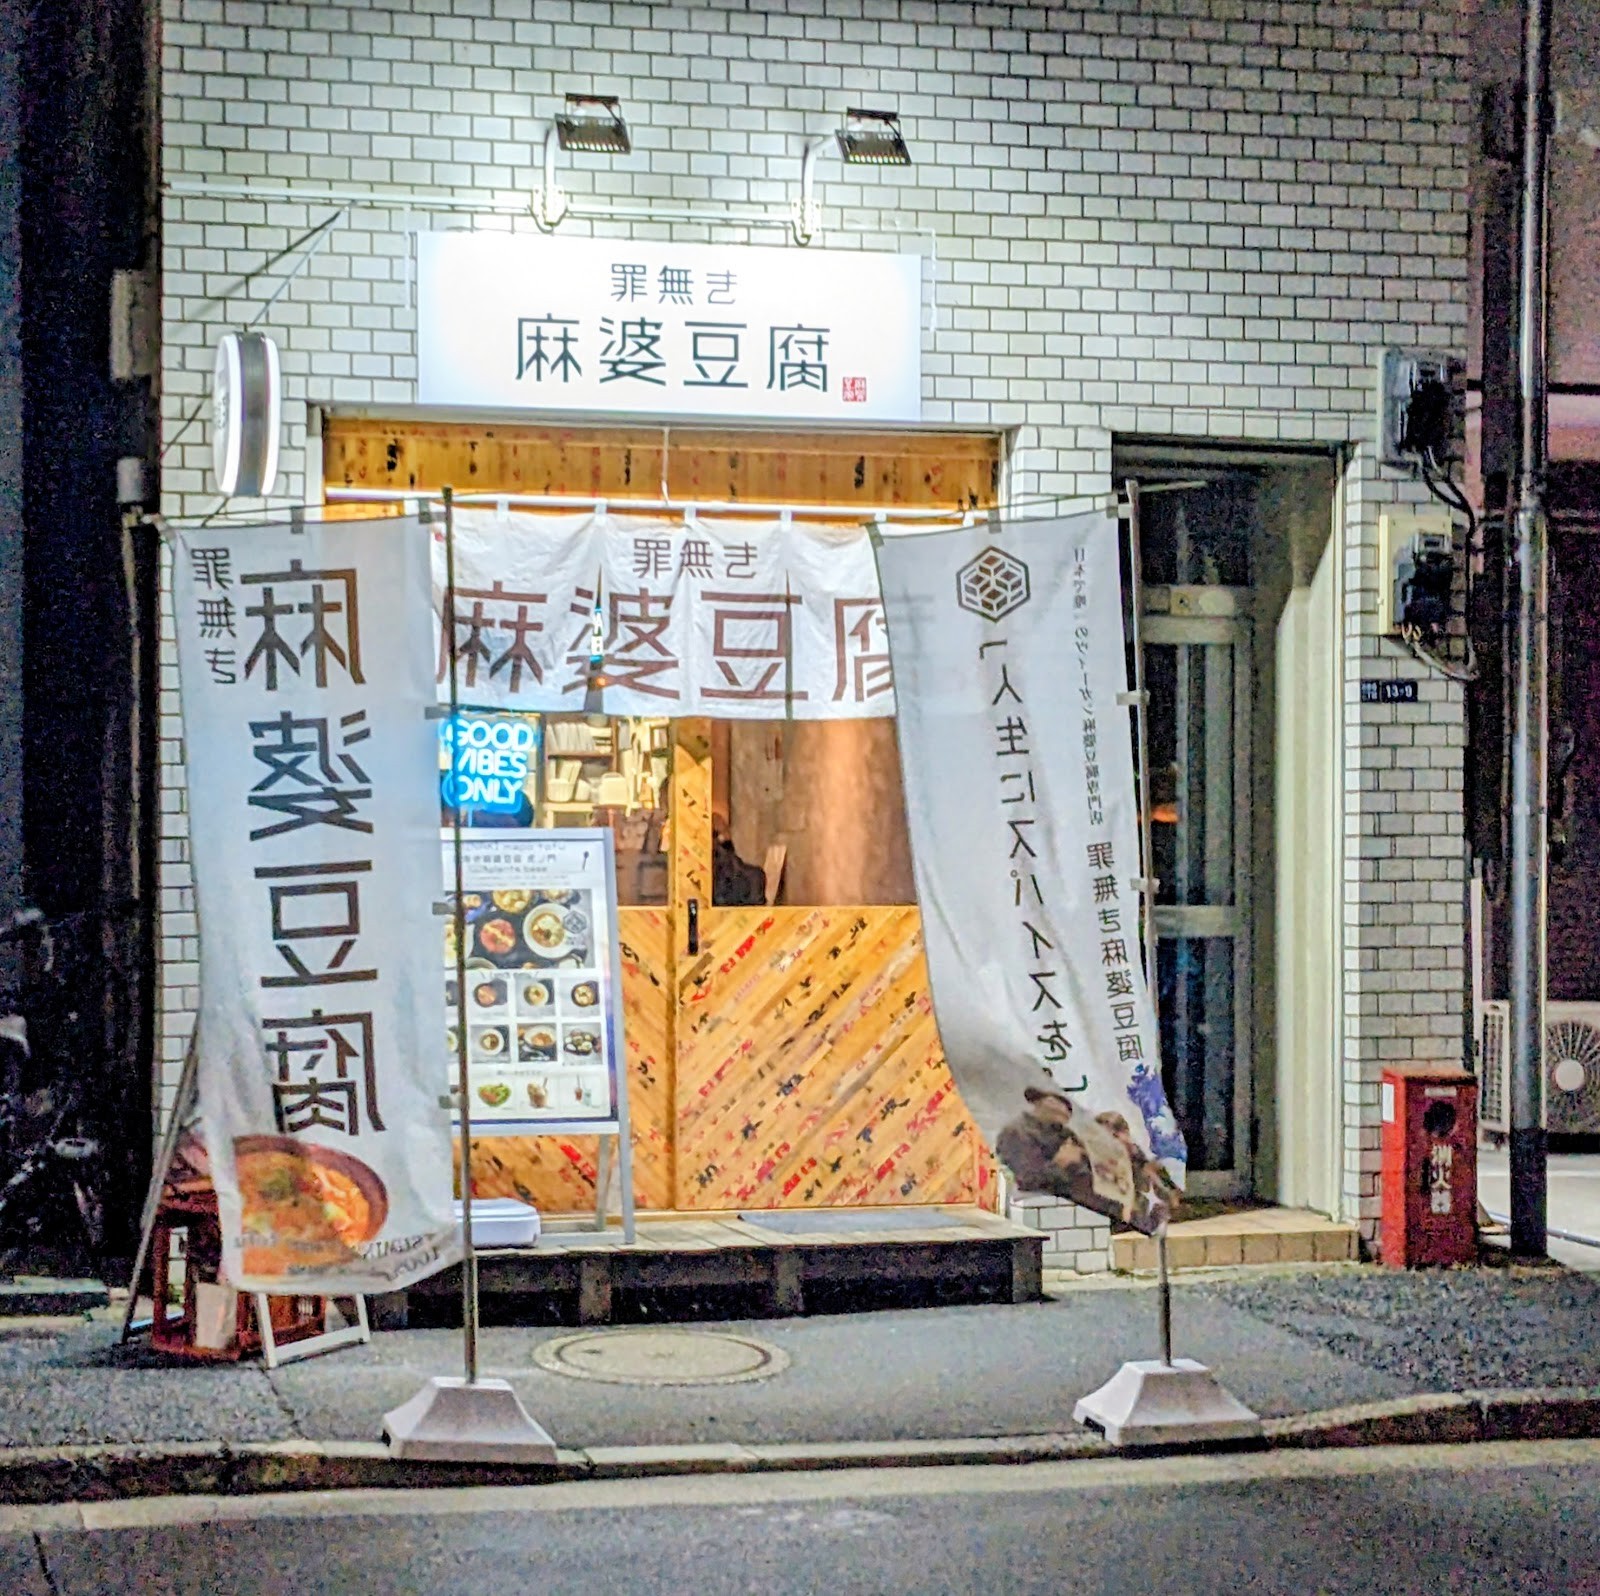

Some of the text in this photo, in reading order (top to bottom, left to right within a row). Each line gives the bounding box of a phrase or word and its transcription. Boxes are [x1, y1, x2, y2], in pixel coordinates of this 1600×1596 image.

[611, 263, 738, 305] 罪無き
[515, 313, 831, 393] 麻婆豆腐
[632, 537, 758, 579] 罪無き
[446, 718, 534, 751] GOOD
[448, 775, 523, 804] ONLY
